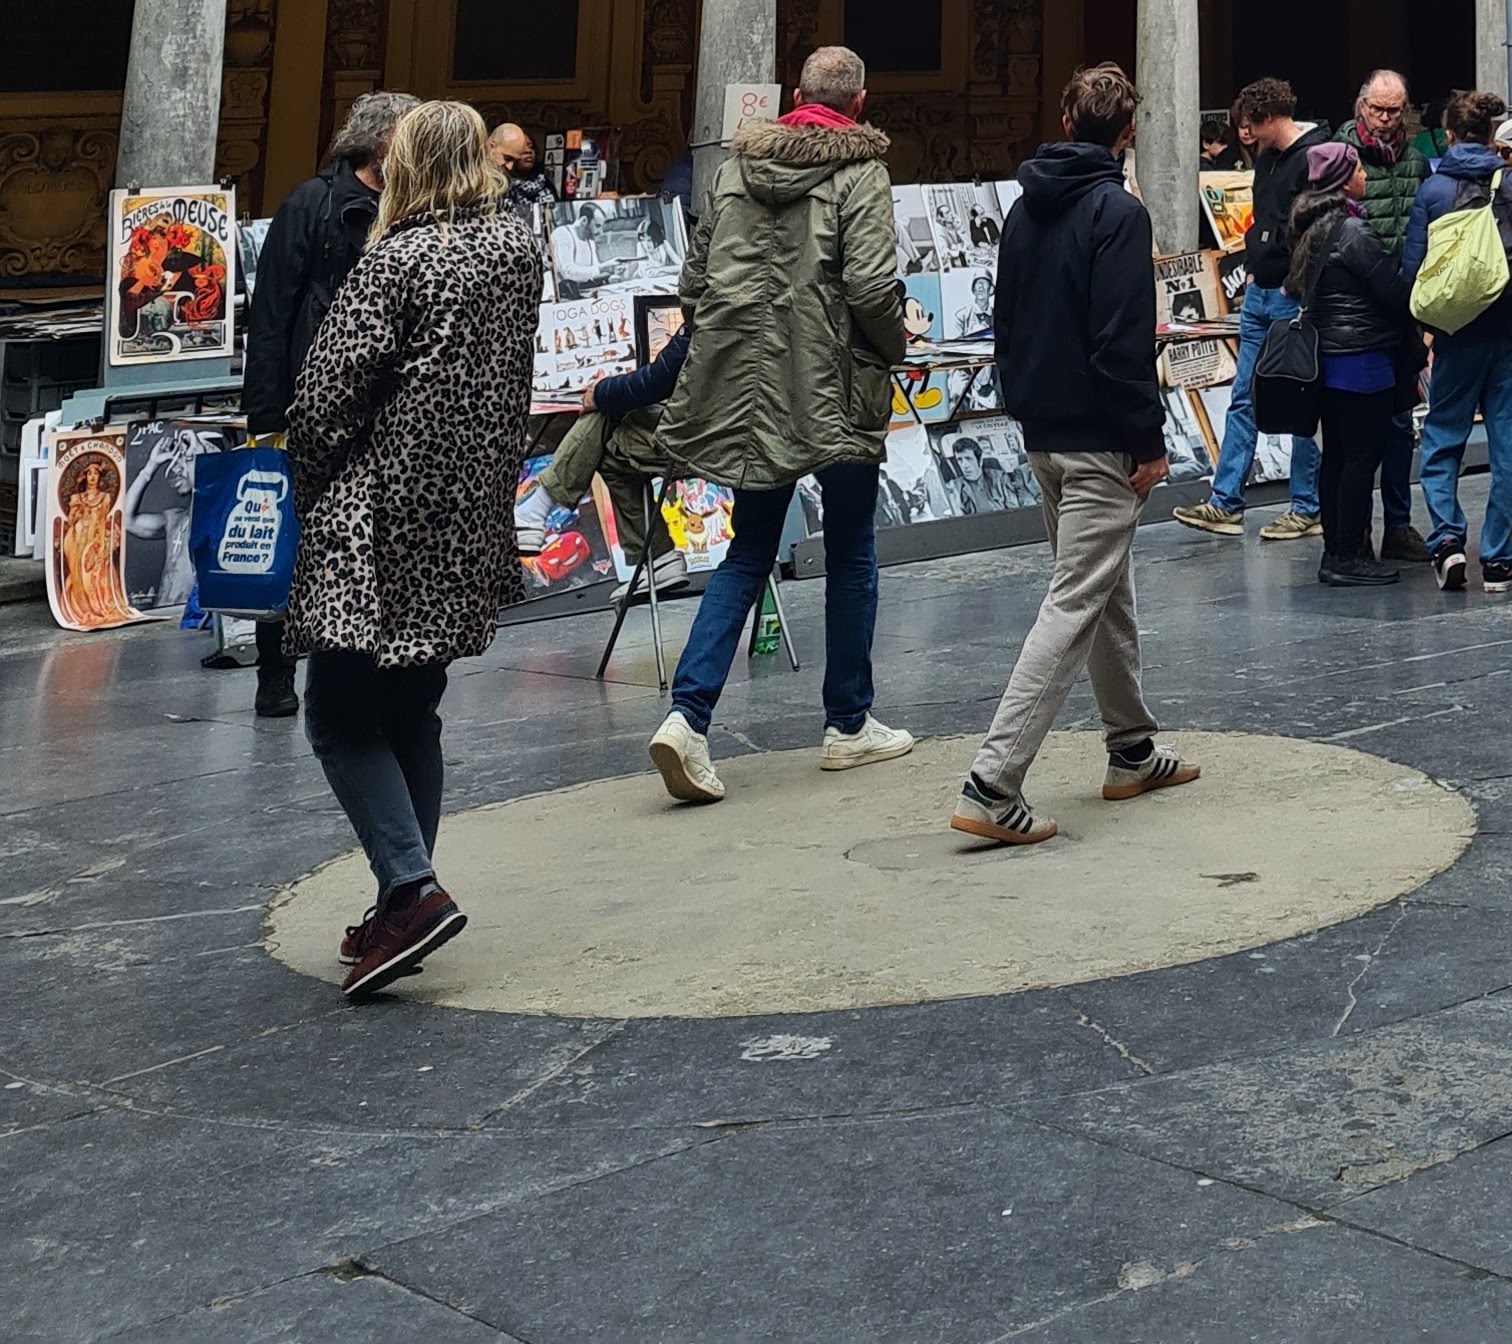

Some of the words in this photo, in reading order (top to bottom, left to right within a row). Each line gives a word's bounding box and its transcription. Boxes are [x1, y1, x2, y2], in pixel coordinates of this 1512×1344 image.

[172, 198, 229, 242] MEUSE
[590, 298, 626, 315] DOGS
[228, 524, 247, 539] du
[249, 524, 275, 540] lait
[225, 540, 259, 550] produit
[260, 542, 271, 551] en
[222, 552, 260, 563] France
